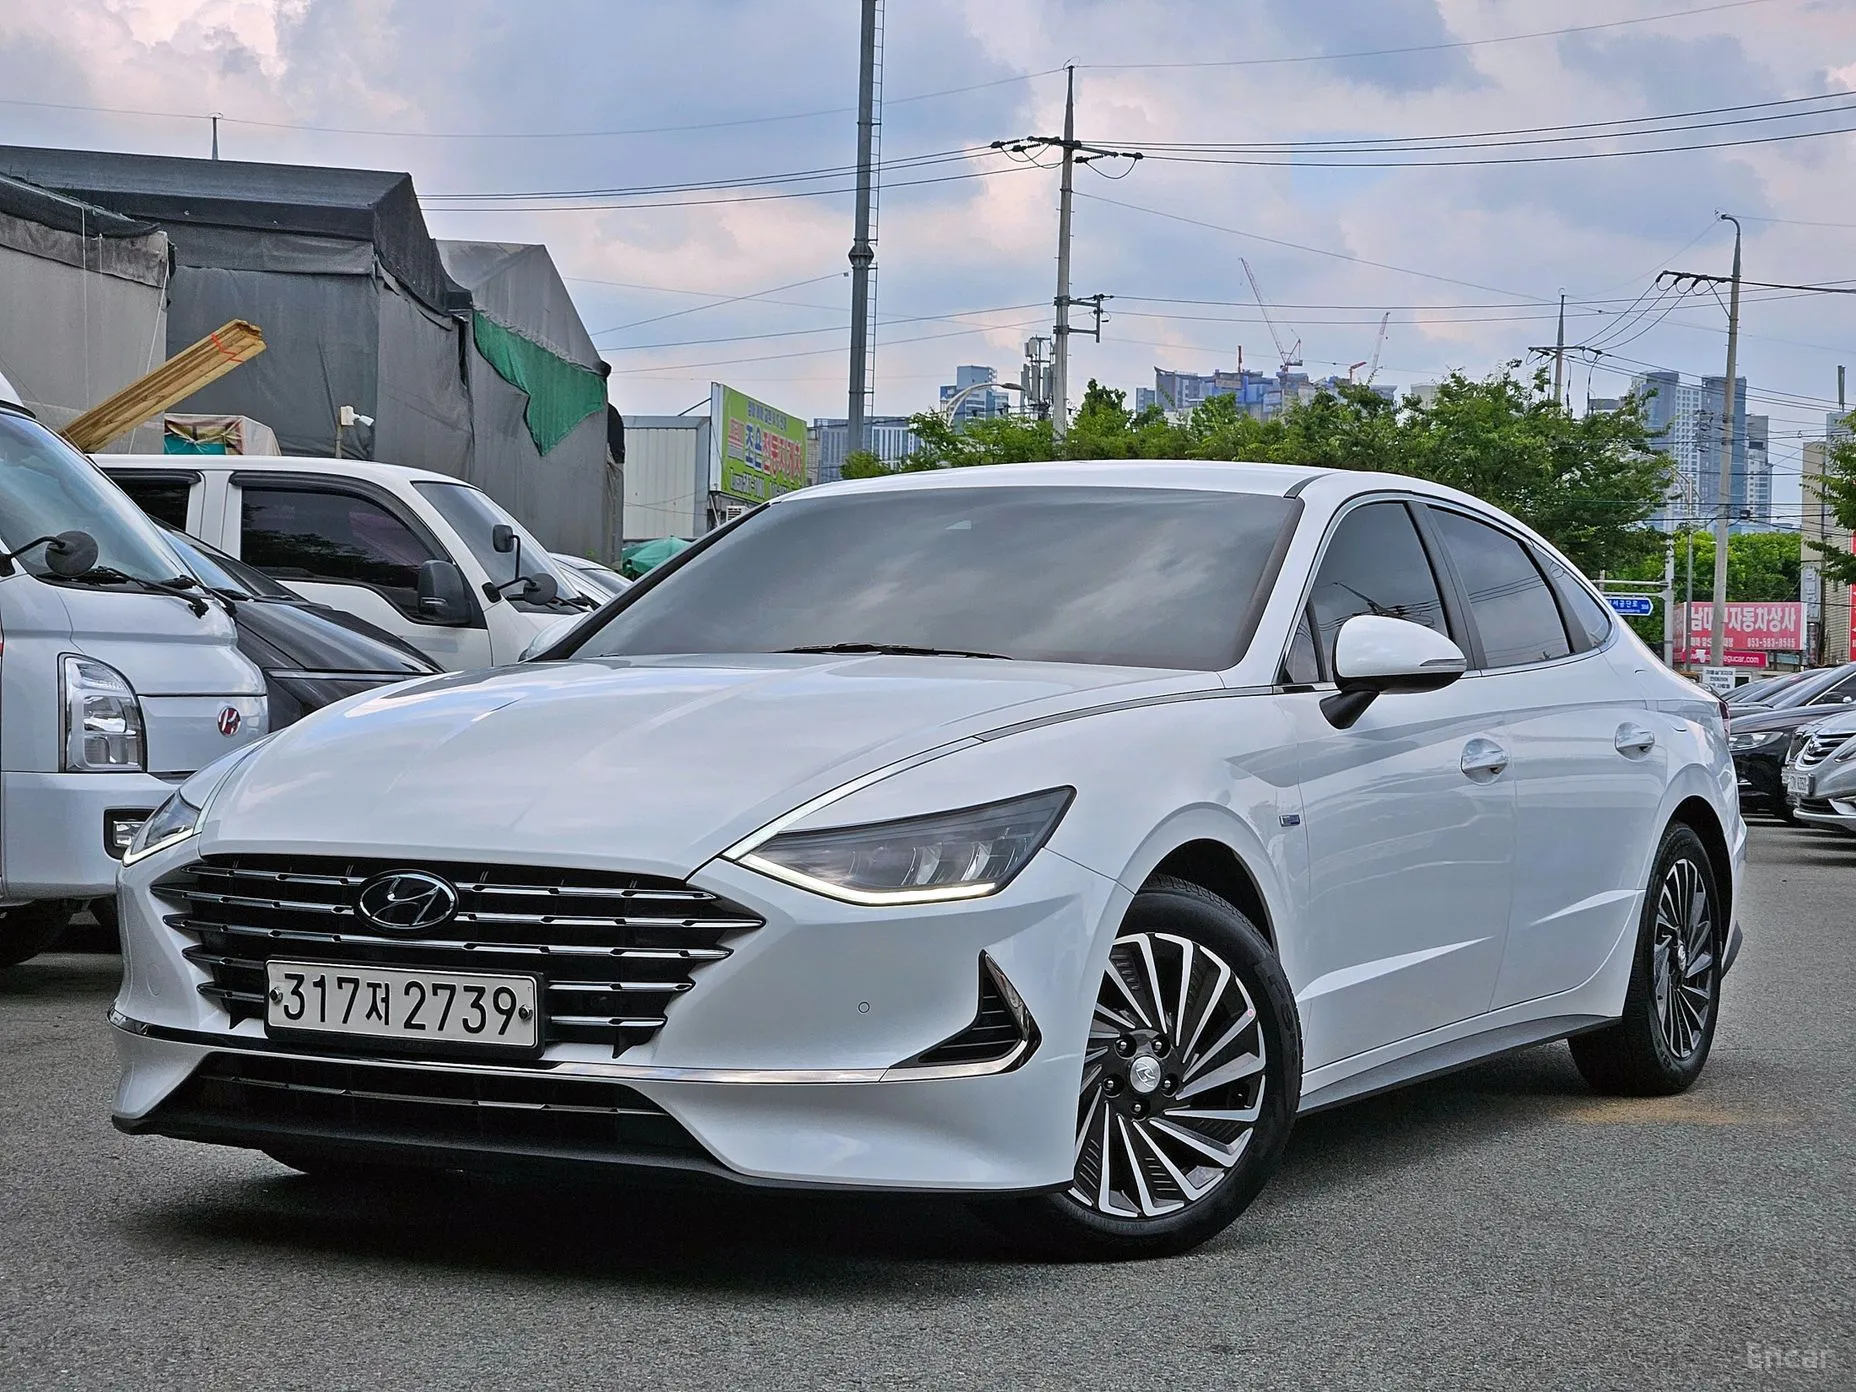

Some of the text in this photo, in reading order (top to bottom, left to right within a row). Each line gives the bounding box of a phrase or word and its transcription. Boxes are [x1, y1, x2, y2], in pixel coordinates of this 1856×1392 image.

[1609, 600, 1638, 608] 서공단로
[1691, 606, 1796, 633] 남대자동차상사
[283, 972, 518, 1036] 317저 2739
